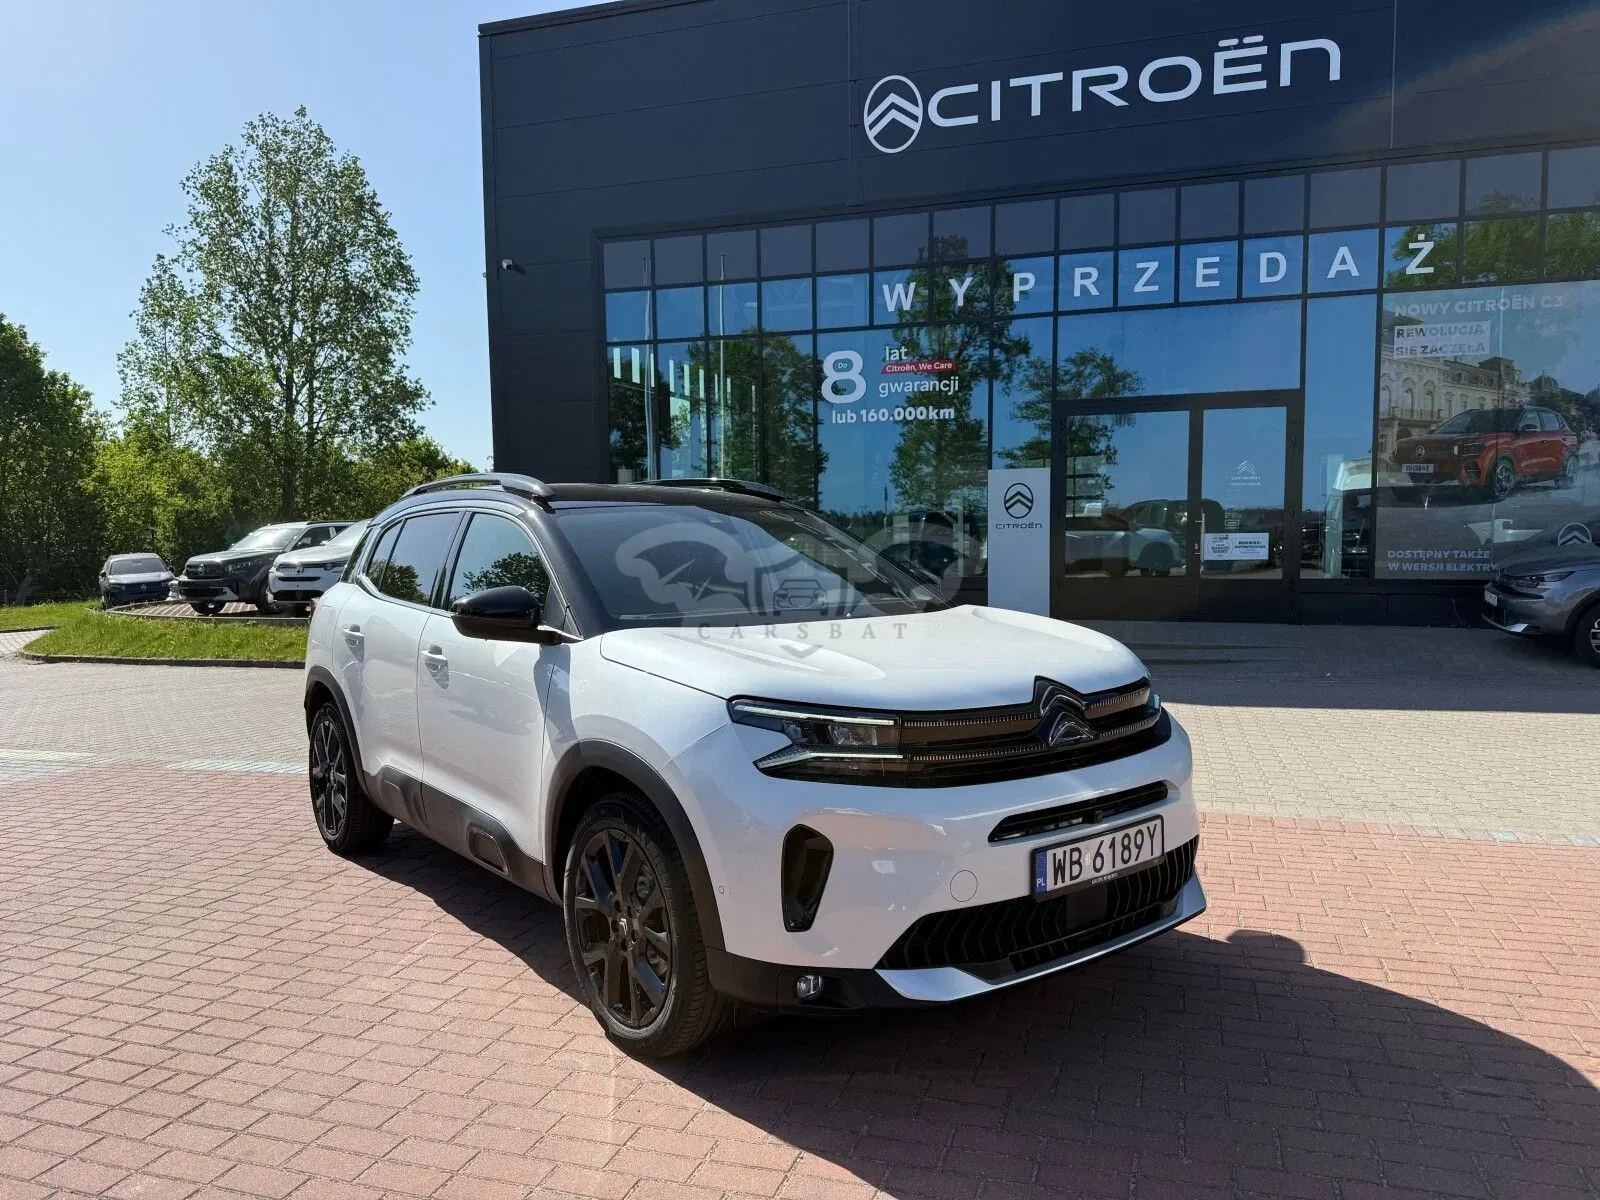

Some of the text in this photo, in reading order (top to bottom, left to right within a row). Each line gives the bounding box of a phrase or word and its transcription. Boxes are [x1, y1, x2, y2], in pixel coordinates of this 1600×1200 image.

[928, 35, 1341, 127] CITROËN
[883, 234, 1435, 312] WYPRZEDAŻ
[1395, 295, 1564, 317] NOWY CITROËN C3
[1396, 324, 1485, 339] REWOLUCJA
[885, 346, 908, 361] lat
[885, 363, 918, 373] Citroën,
[933, 361, 953, 370] Care
[821, 350, 867, 404] 8
[879, 376, 959, 397] gwarancji
[832, 410, 857, 424] lub
[995, 521, 1043, 530] CITROËN
[1387, 549, 1490, 560] DOSTĘPNY TAKŻE
[1388, 562, 1400, 571] W
[1401, 562, 1444, 571] WERSJI
[1053, 823, 1158, 886] WB 6189Y
[1036, 878, 1046, 888] PL
